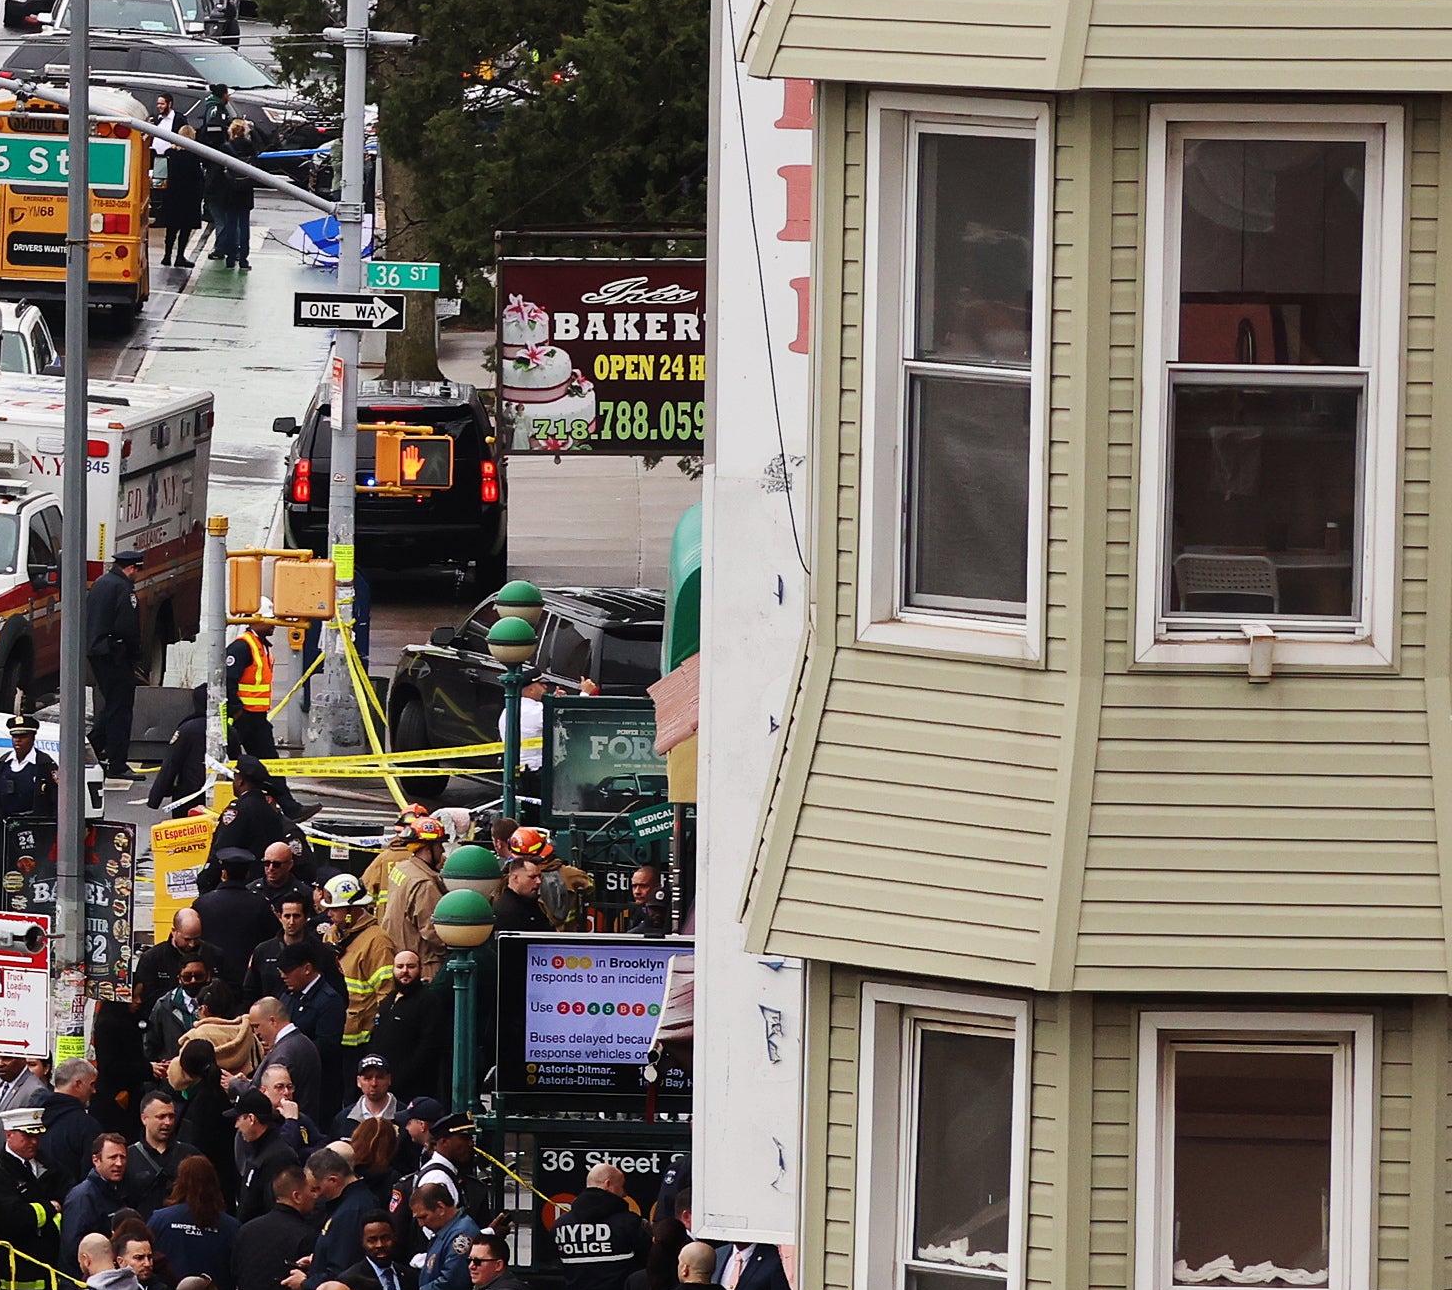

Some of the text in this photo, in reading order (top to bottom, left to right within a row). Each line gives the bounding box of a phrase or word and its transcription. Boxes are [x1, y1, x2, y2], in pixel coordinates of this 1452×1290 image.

[28, 146, 70, 175] St
[376, 265, 428, 286] 36 ST
[310, 303, 388, 320] ONE WAY
[554, 312, 705, 341] BAKER
[154, 824, 208, 842] El Especialito
[531, 956, 664, 970] No in Brooklyn
[6, 971, 24, 982] Truck
[530, 972, 663, 986] responds to an incident
[6, 981, 32, 994] Loading
[6, 991, 21, 1002] Only
[7, 1019, 30, 1030] Sunday
[529, 1032, 652, 1047] Buses delayed becau
[542, 1150, 660, 1174] 36 Street
[558, 1242, 612, 1255] POLICE
